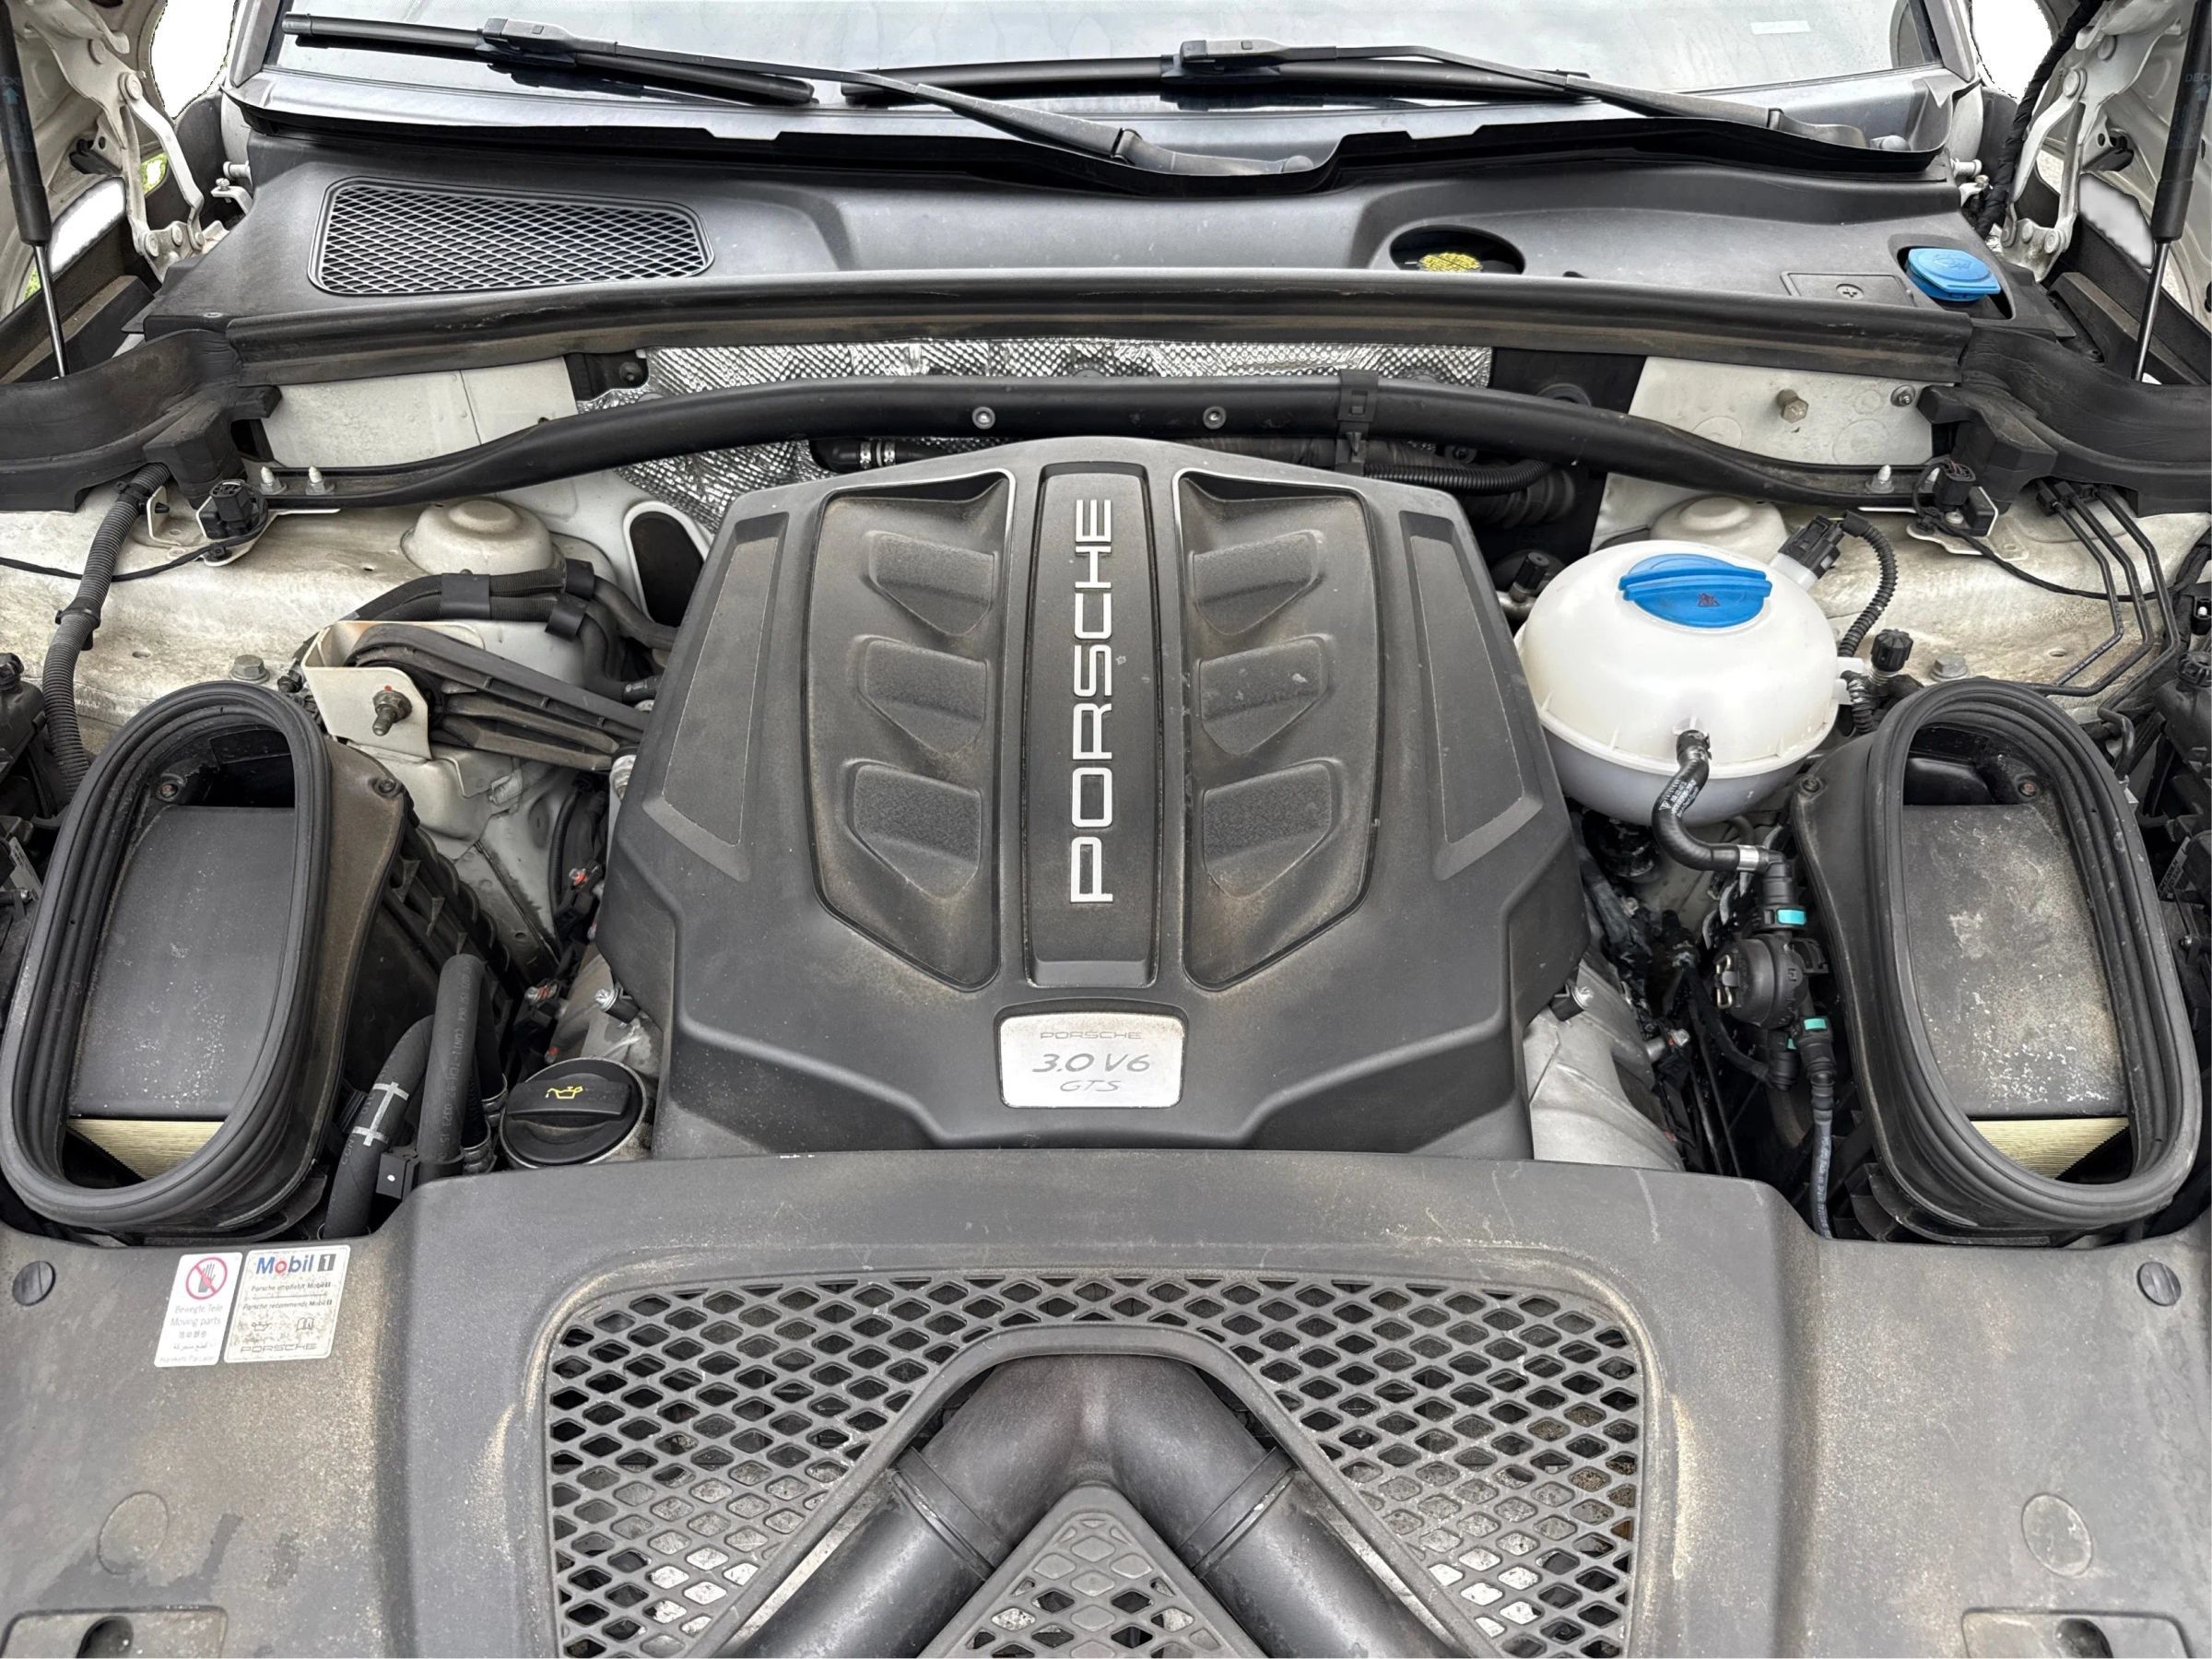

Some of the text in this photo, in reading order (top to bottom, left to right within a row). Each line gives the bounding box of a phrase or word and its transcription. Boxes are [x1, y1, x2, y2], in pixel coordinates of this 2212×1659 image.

[1070, 499, 1113, 903] PORSCHE
[1040, 1031, 1144, 1040] PORSCHE
[1031, 1053, 1151, 1073] 3.0 V6
[1059, 1080, 1122, 1092] GTS
[255, 1253, 336, 1275] Mobil 1
[171, 1316, 221, 1327] Moving parts
[241, 1343, 318, 1353] PORSCHE
